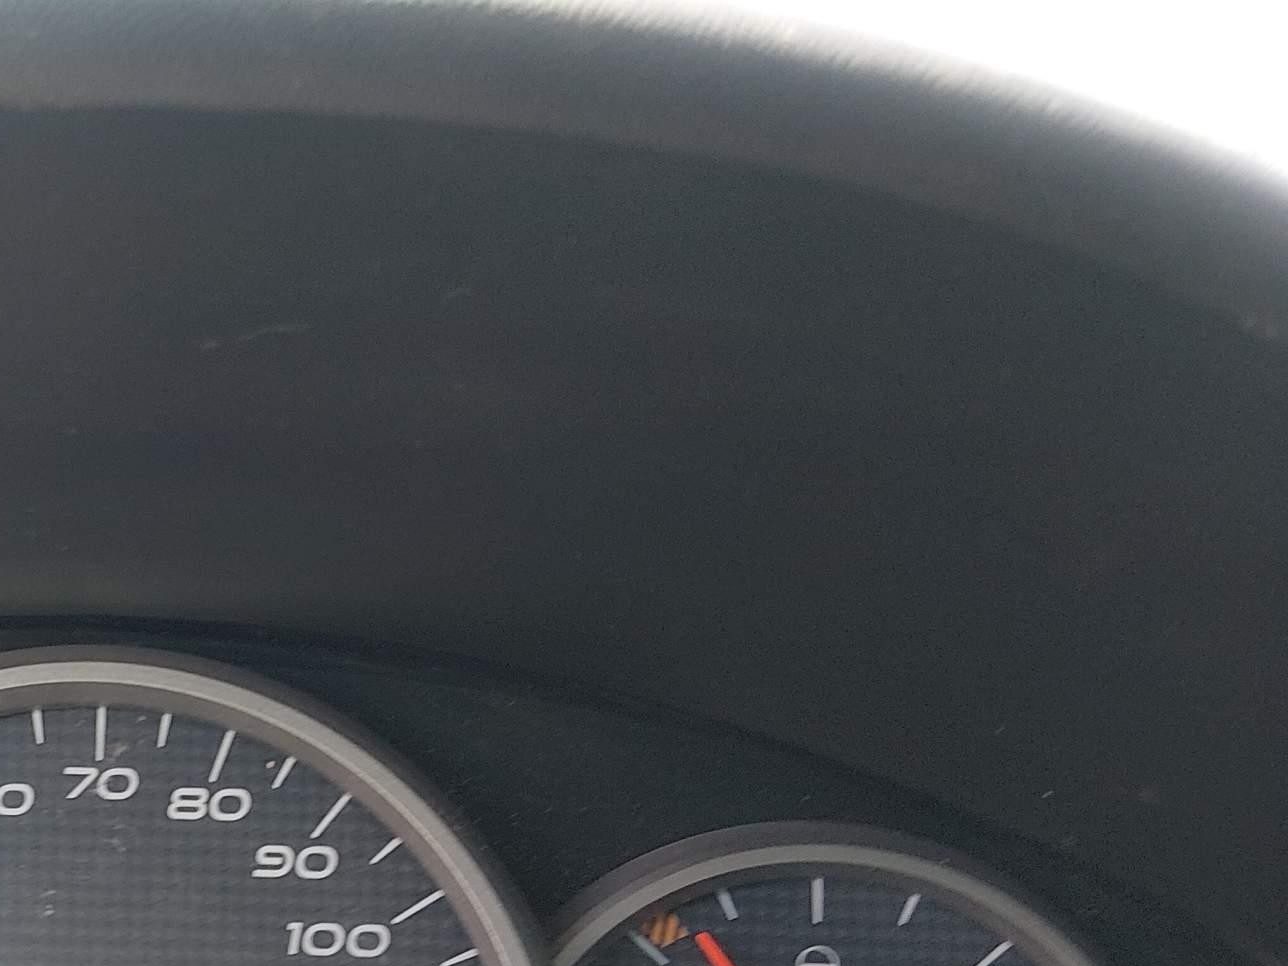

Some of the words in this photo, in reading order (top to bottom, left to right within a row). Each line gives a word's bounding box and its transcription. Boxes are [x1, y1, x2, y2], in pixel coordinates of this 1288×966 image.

[62, 767, 140, 800] 70
[166, 786, 252, 821] 80
[251, 845, 339, 880] 90
[285, 922, 392, 959] 100
